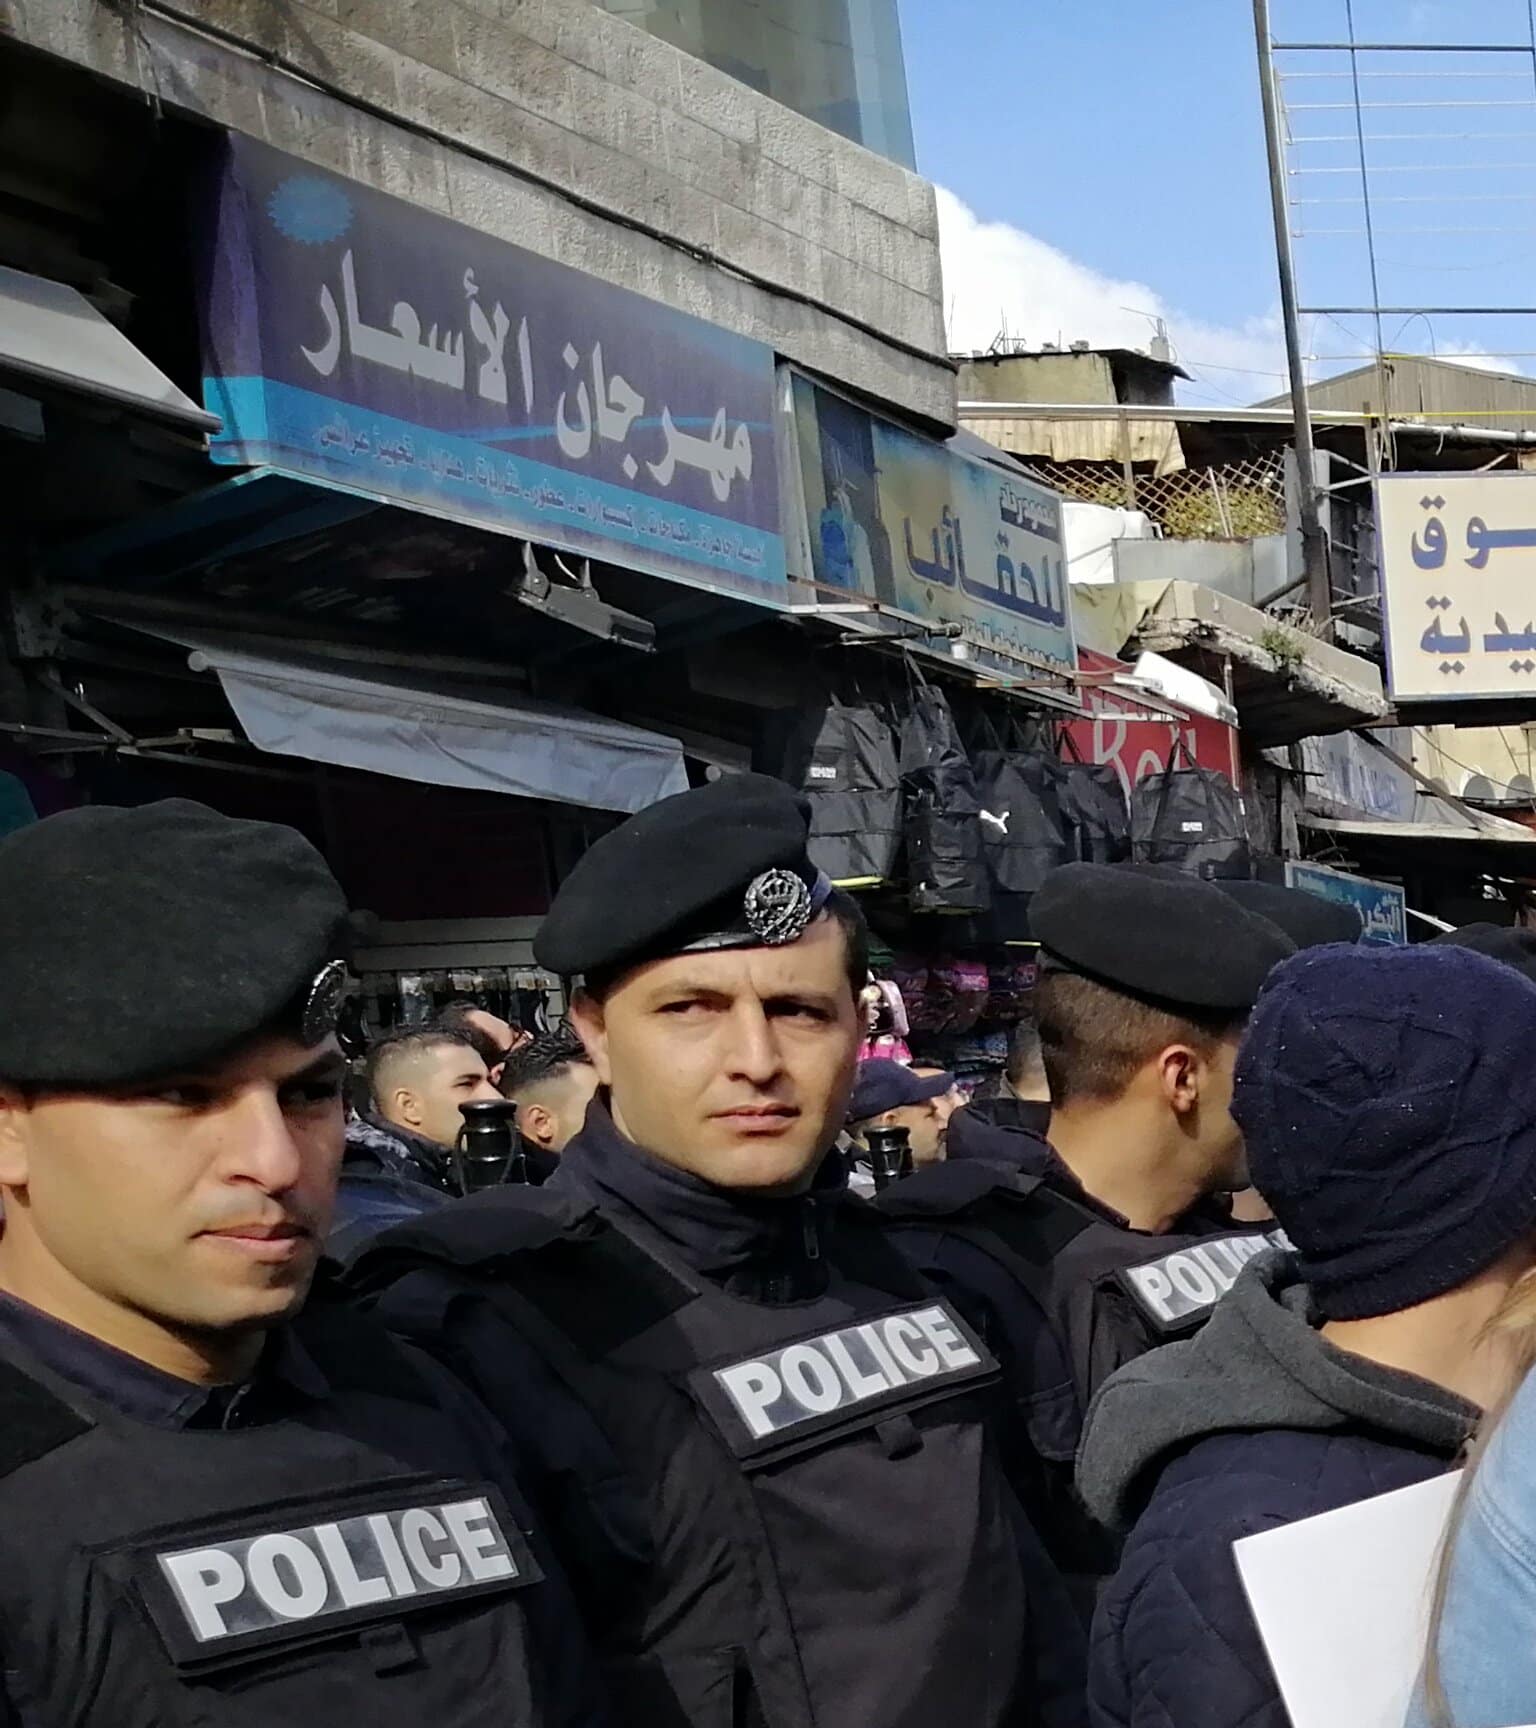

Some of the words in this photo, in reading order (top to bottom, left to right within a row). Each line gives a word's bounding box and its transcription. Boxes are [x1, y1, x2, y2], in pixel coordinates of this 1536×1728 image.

[301, 250, 534, 415] الأسعار
[557, 342, 753, 503] مهرجان
[903, 504, 1066, 629] للحقائب
[721, 1307, 982, 1435] POLICE
[165, 1499, 514, 1639] POLICE
